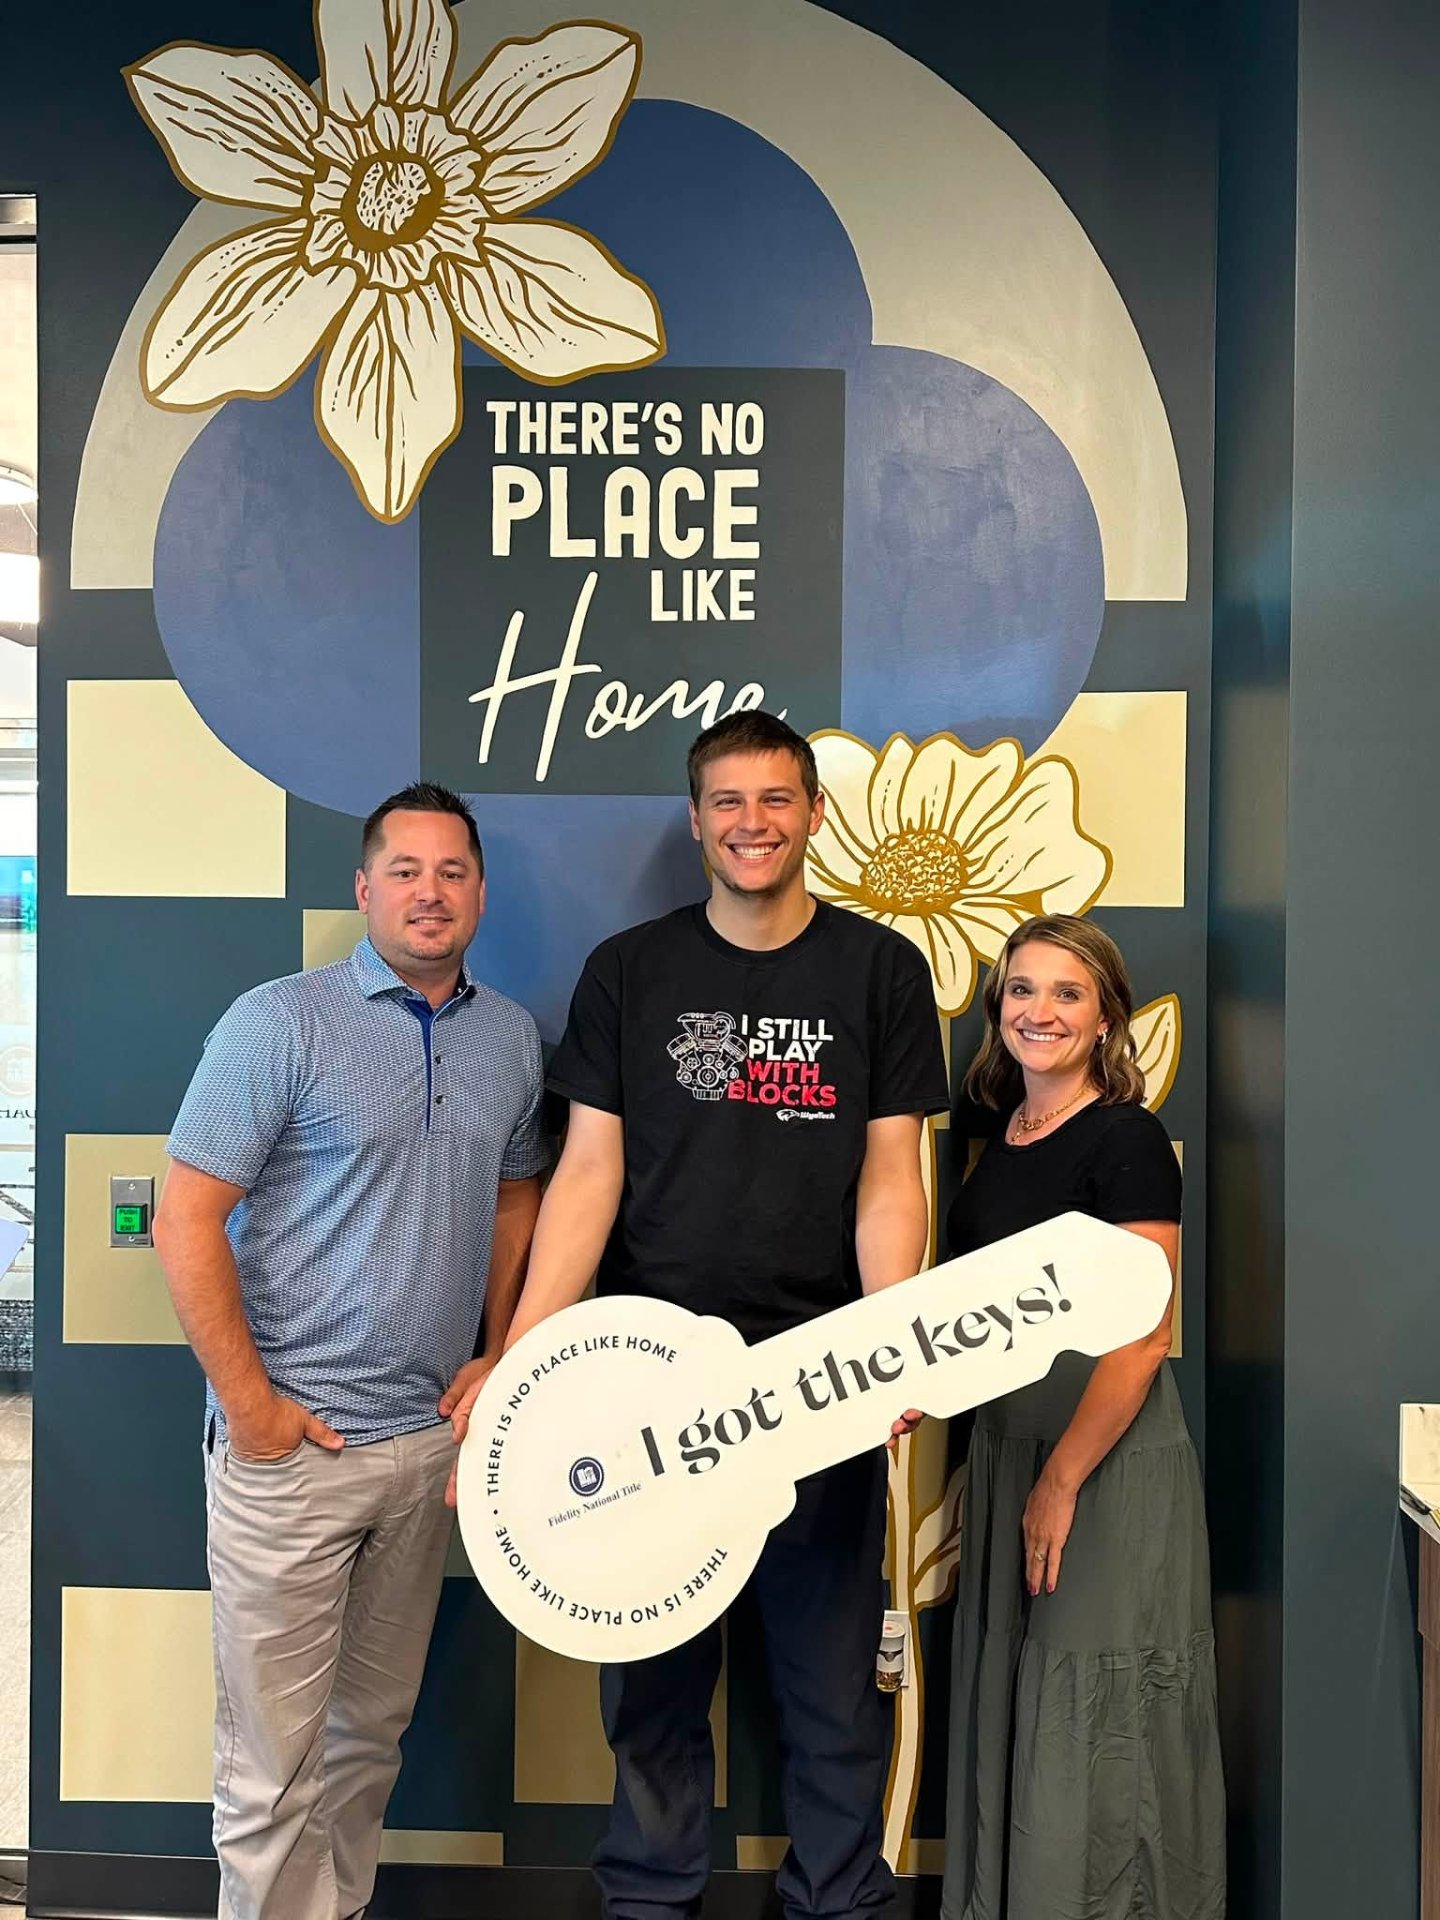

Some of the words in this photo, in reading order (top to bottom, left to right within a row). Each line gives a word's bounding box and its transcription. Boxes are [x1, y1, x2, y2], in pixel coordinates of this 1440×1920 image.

[486, 401, 683, 456] THERE'S
[701, 402, 765, 456] NO
[491, 465, 761, 560] PLACE
[650, 569, 756, 622] LIKE
[741, 1014, 749, 1036] I
[757, 1017, 834, 1041] STILL
[748, 1037, 823, 1063] PLAY
[745, 1059, 820, 1084] WITH
[727, 1079, 837, 1107] BLOCKS
[640, 1426, 665, 1477] I
[678, 1387, 783, 1475] got
[793, 1345, 904, 1411] the
[911, 1263, 1072, 1366] keys!
[487, 1437, 504, 1496] THERE
[497, 1414, 512, 1432] IS
[508, 1382, 531, 1410] NO
[531, 1343, 579, 1382] PLACE
[584, 1335, 620, 1353] LIKE
[626, 1336, 677, 1363] HOME
[548, 1507, 581, 1528] Fidelity
[583, 1490, 620, 1513] National
[620, 1482, 642, 1498] Title
[495, 1526, 531, 1581] HOME
[684, 1548, 728, 1599] THERE
[530, 1579, 564, 1610] LIKE
[665, 1593, 682, 1612] IS
[569, 1602, 622, 1626] PLACE
[630, 1604, 659, 1624] NO
